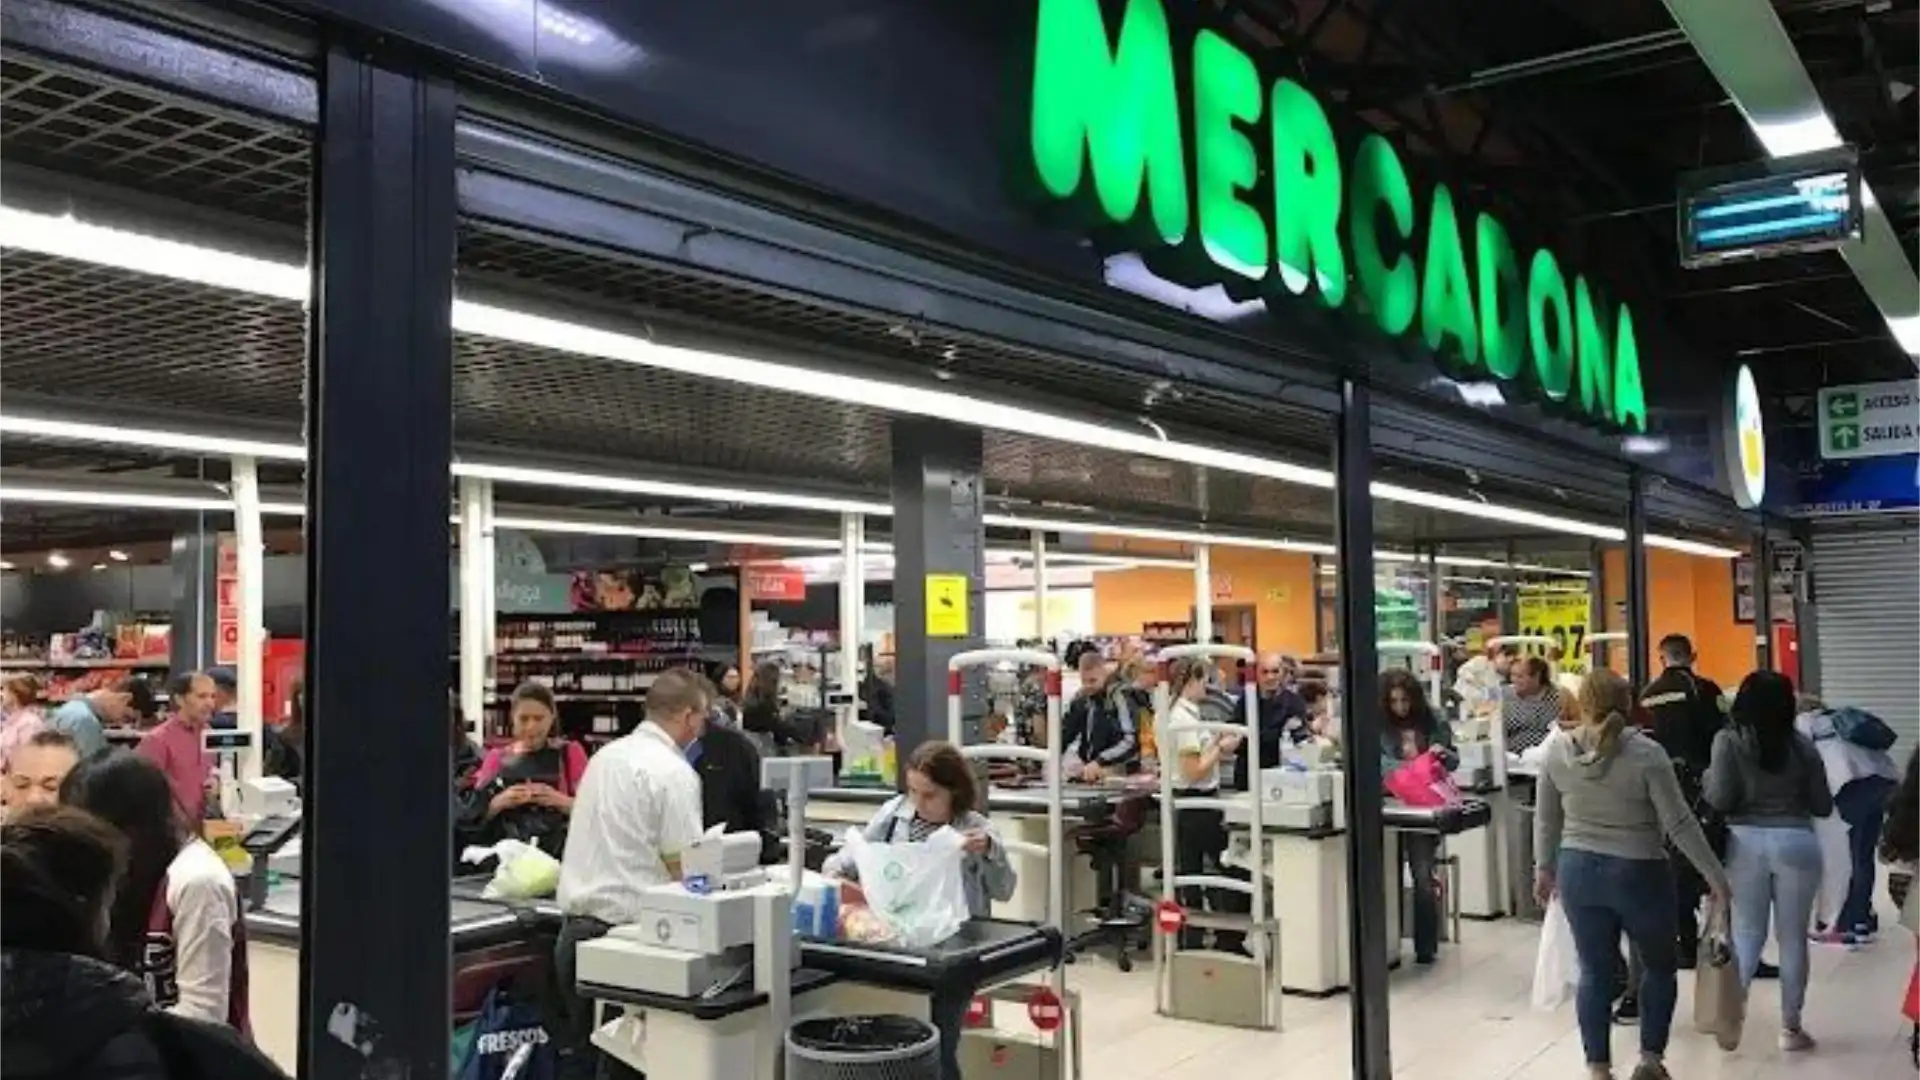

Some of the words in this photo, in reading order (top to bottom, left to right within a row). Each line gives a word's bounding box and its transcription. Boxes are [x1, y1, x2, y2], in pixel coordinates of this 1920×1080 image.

[1032, 0, 1647, 434] MERCADONA
[1863, 423, 1912, 442] SALIDA
[477, 1025, 549, 1055] FRESCOS
